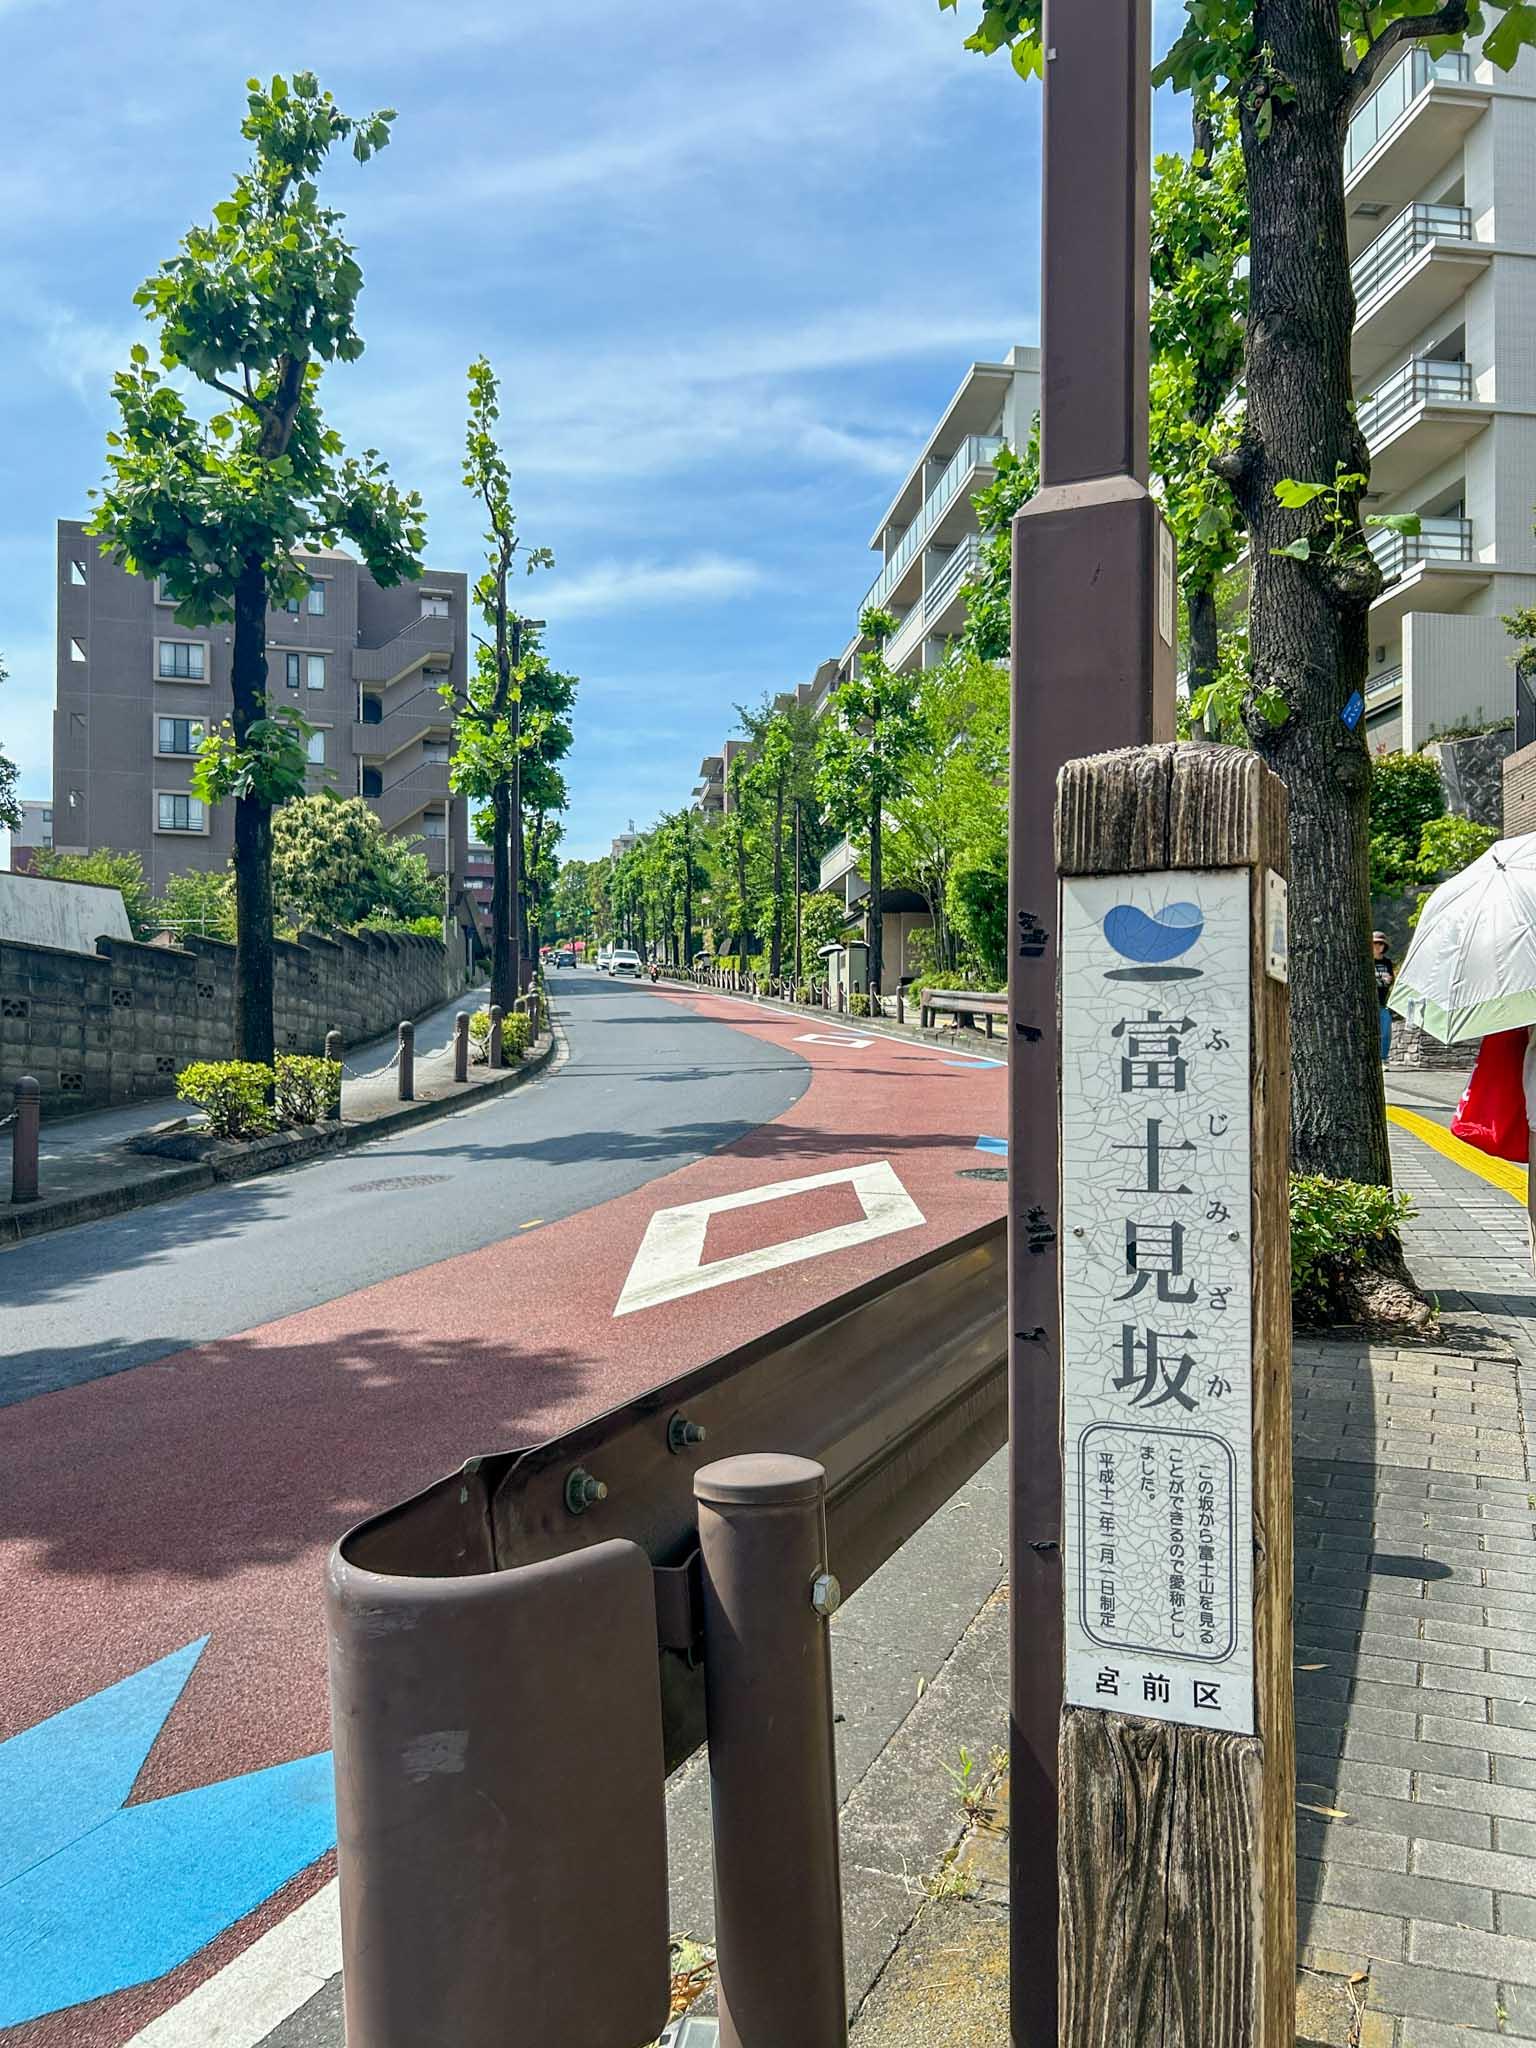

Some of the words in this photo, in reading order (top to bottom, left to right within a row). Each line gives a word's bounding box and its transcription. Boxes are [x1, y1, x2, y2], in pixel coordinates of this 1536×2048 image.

[1111, 1010, 1199, 1413] 富士見坂
[1204, 1028, 1232, 1399] ふじみざか
[1099, 1452, 1116, 1629] 平成十二年二月一日制定
[1140, 1446, 1156, 1500] ました。
[1169, 1448, 1186, 1639] ことができるので愛称とし
[1198, 1465, 1215, 1645] この坂から富士山を見る
[1095, 1666, 1222, 1710] 宮前区
